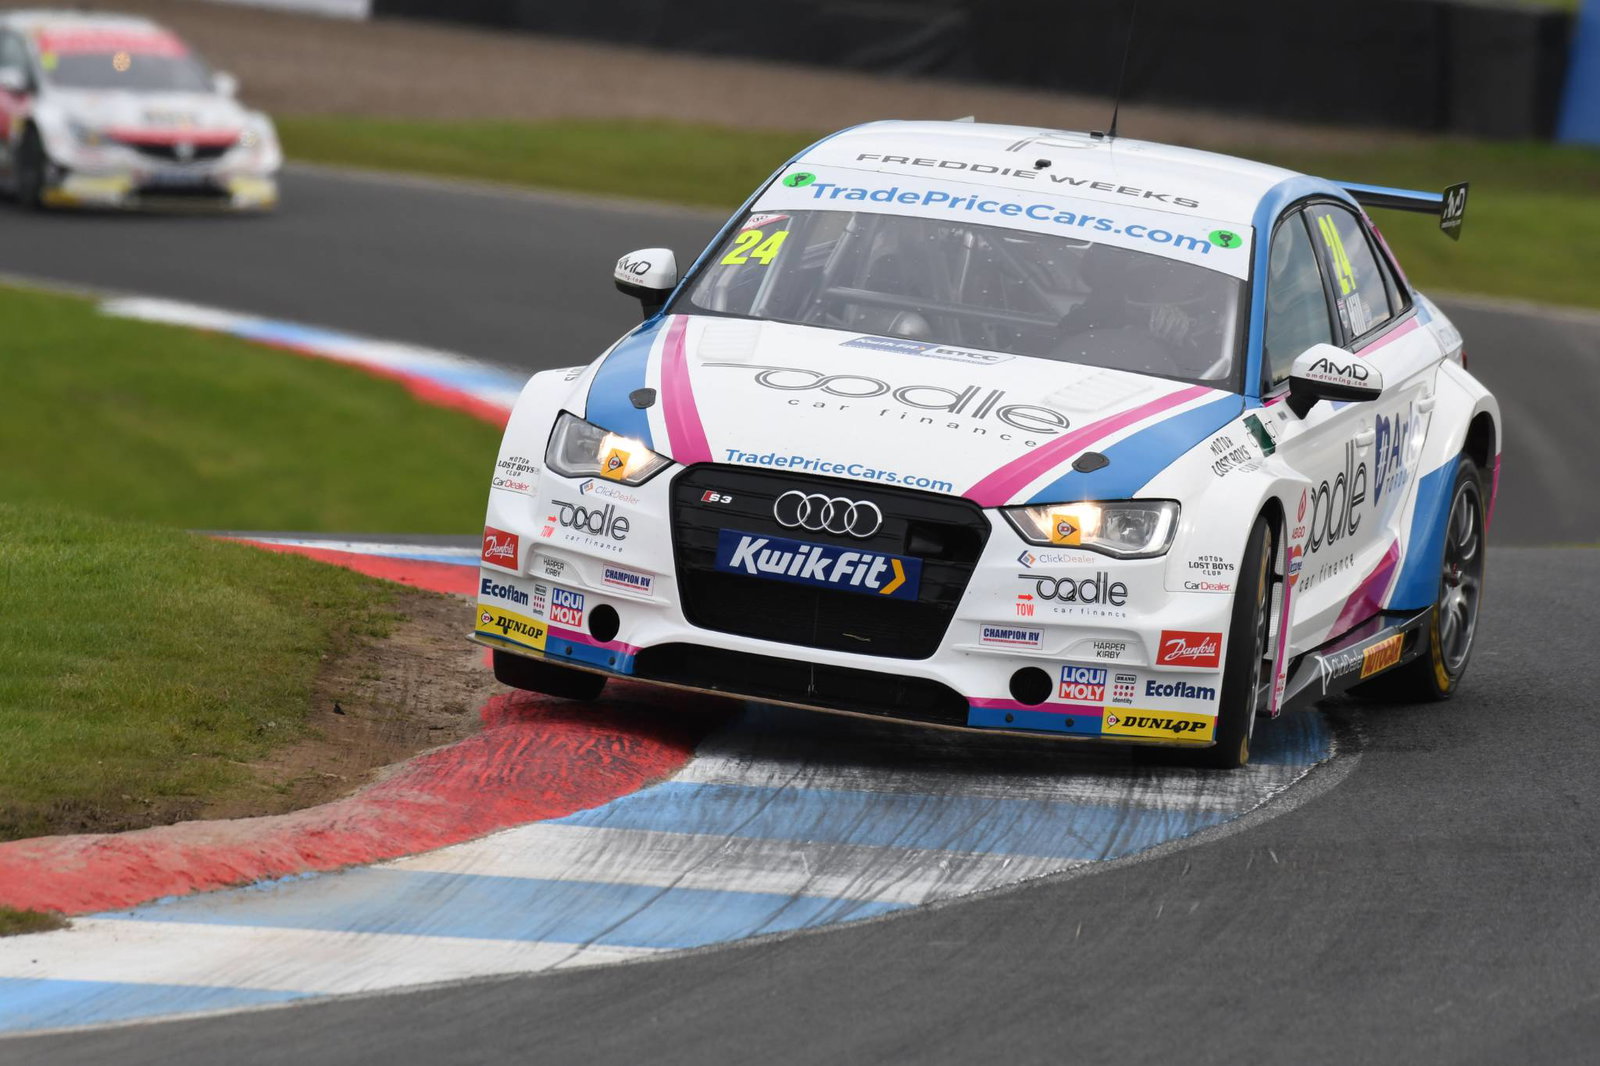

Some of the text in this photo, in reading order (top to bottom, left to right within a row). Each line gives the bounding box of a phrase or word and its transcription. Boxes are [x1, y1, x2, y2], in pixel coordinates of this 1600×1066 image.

[856, 153, 1200, 209] FREDDIE WEEKS
[811, 183, 1212, 255] TradePriceCars.com
[720, 230, 789, 265] 24
[1309, 358, 1369, 381] AMD
[701, 362, 1070, 435] oodle
[787, 398, 1037, 448] car finance
[497, 460, 535, 474] LOST BOYS
[725, 448, 953, 493] TradePriceCars.com
[594, 485, 641, 505] ClickDealer
[551, 499, 630, 541] oodle
[543, 558, 565, 571] HARPER
[1039, 554, 1096, 564] ClickDealer
[1189, 561, 1235, 571] LOST BOYS
[604, 568, 640, 585] CHAMPION
[640, 576, 651, 588] RV
[1018, 571, 1128, 606] oodle
[480, 578, 529, 607] Ecoflam
[552, 589, 583, 611] LIQUI
[551, 606, 582, 626] MOLY
[1016, 602, 1035, 616] TOW
[495, 615, 543, 640] DUNLOP
[983, 628, 1027, 640] CHAMPION
[1028, 632, 1040, 642] RV
[1093, 641, 1126, 651] HARPER
[1096, 650, 1120, 660] KIRBY
[1164, 635, 1216, 661] Danfoss
[1062, 667, 1106, 685] LIQUI
[1060, 682, 1105, 701] MOLY
[1145, 679, 1216, 701] Ecoflam
[1122, 715, 1207, 733] DUNLOP
